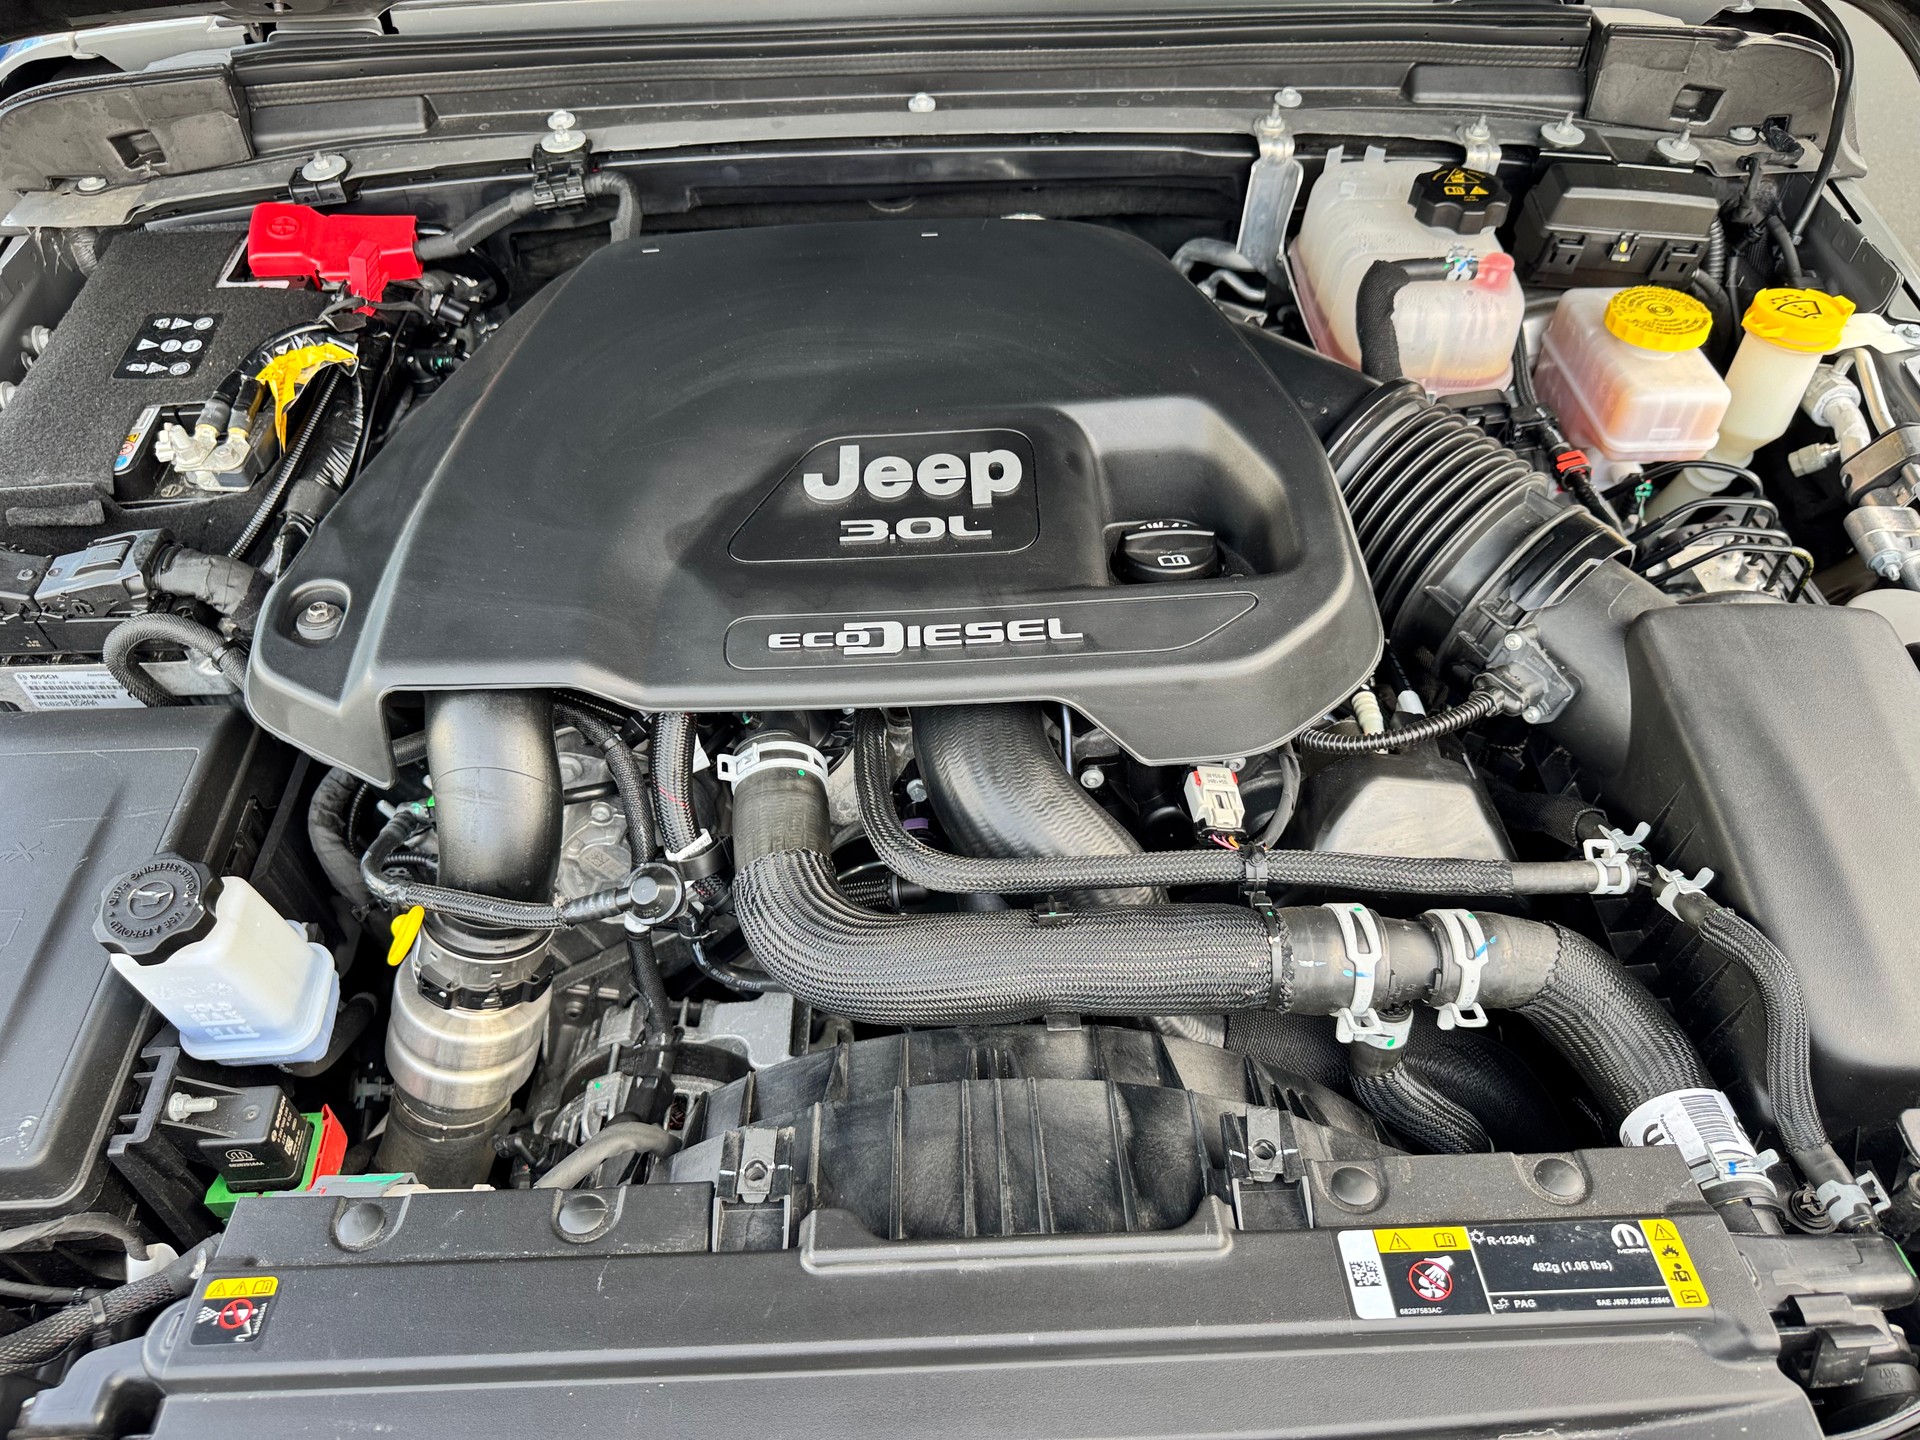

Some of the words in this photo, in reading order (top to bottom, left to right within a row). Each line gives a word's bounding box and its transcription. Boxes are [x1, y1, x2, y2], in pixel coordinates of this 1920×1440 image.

[803, 445, 1023, 506] Jeep
[839, 515, 993, 544] 3.0L
[129, 862, 179, 881] STEERING
[178, 866, 197, 897] POWER
[107, 878, 131, 907] FLUID
[109, 920, 162, 939] APPROVED
[162, 909, 184, 930] USE
[275, 1096, 286, 1128] BOSCH
[1486, 1234, 1536, 1246] R-1234yf
[1532, 1261, 1560, 1274] 482g
[1562, 1261, 1589, 1274] (1.06
[1590, 1259, 1613, 1272] lbs)
[1513, 1299, 1537, 1309] PAG
[1612, 1298, 1629, 1306] J639
